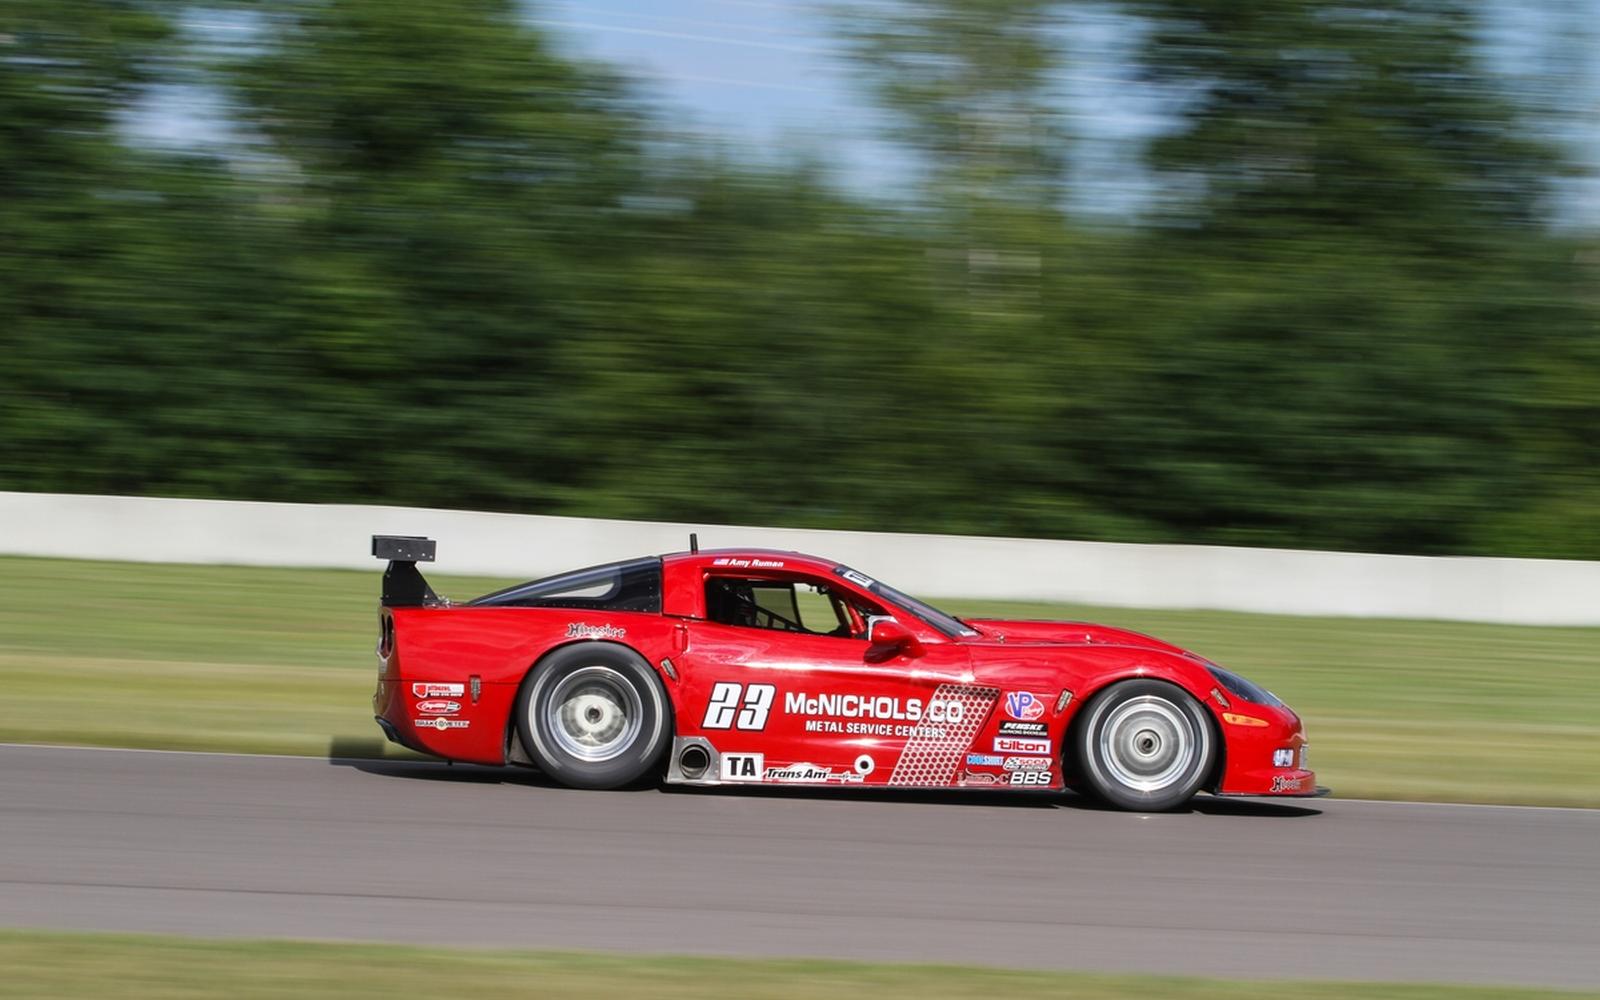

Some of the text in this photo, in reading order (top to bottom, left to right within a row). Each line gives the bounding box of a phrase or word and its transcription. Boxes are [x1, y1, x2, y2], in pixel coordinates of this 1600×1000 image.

[729, 558, 750, 567] Amy
[701, 682, 776, 731] 23
[784, 692, 922, 720] McNICHOLS
[1008, 692, 1033, 719] VP
[805, 720, 945, 738] METAL SERVICE CENTERS
[1003, 722, 1044, 730] PENSKE
[998, 740, 1047, 752] tilton
[727, 757, 755, 771] TA
[766, 768, 801, 779] Trans
[803, 769, 827, 779] Am
[1010, 772, 1052, 785] BBS
